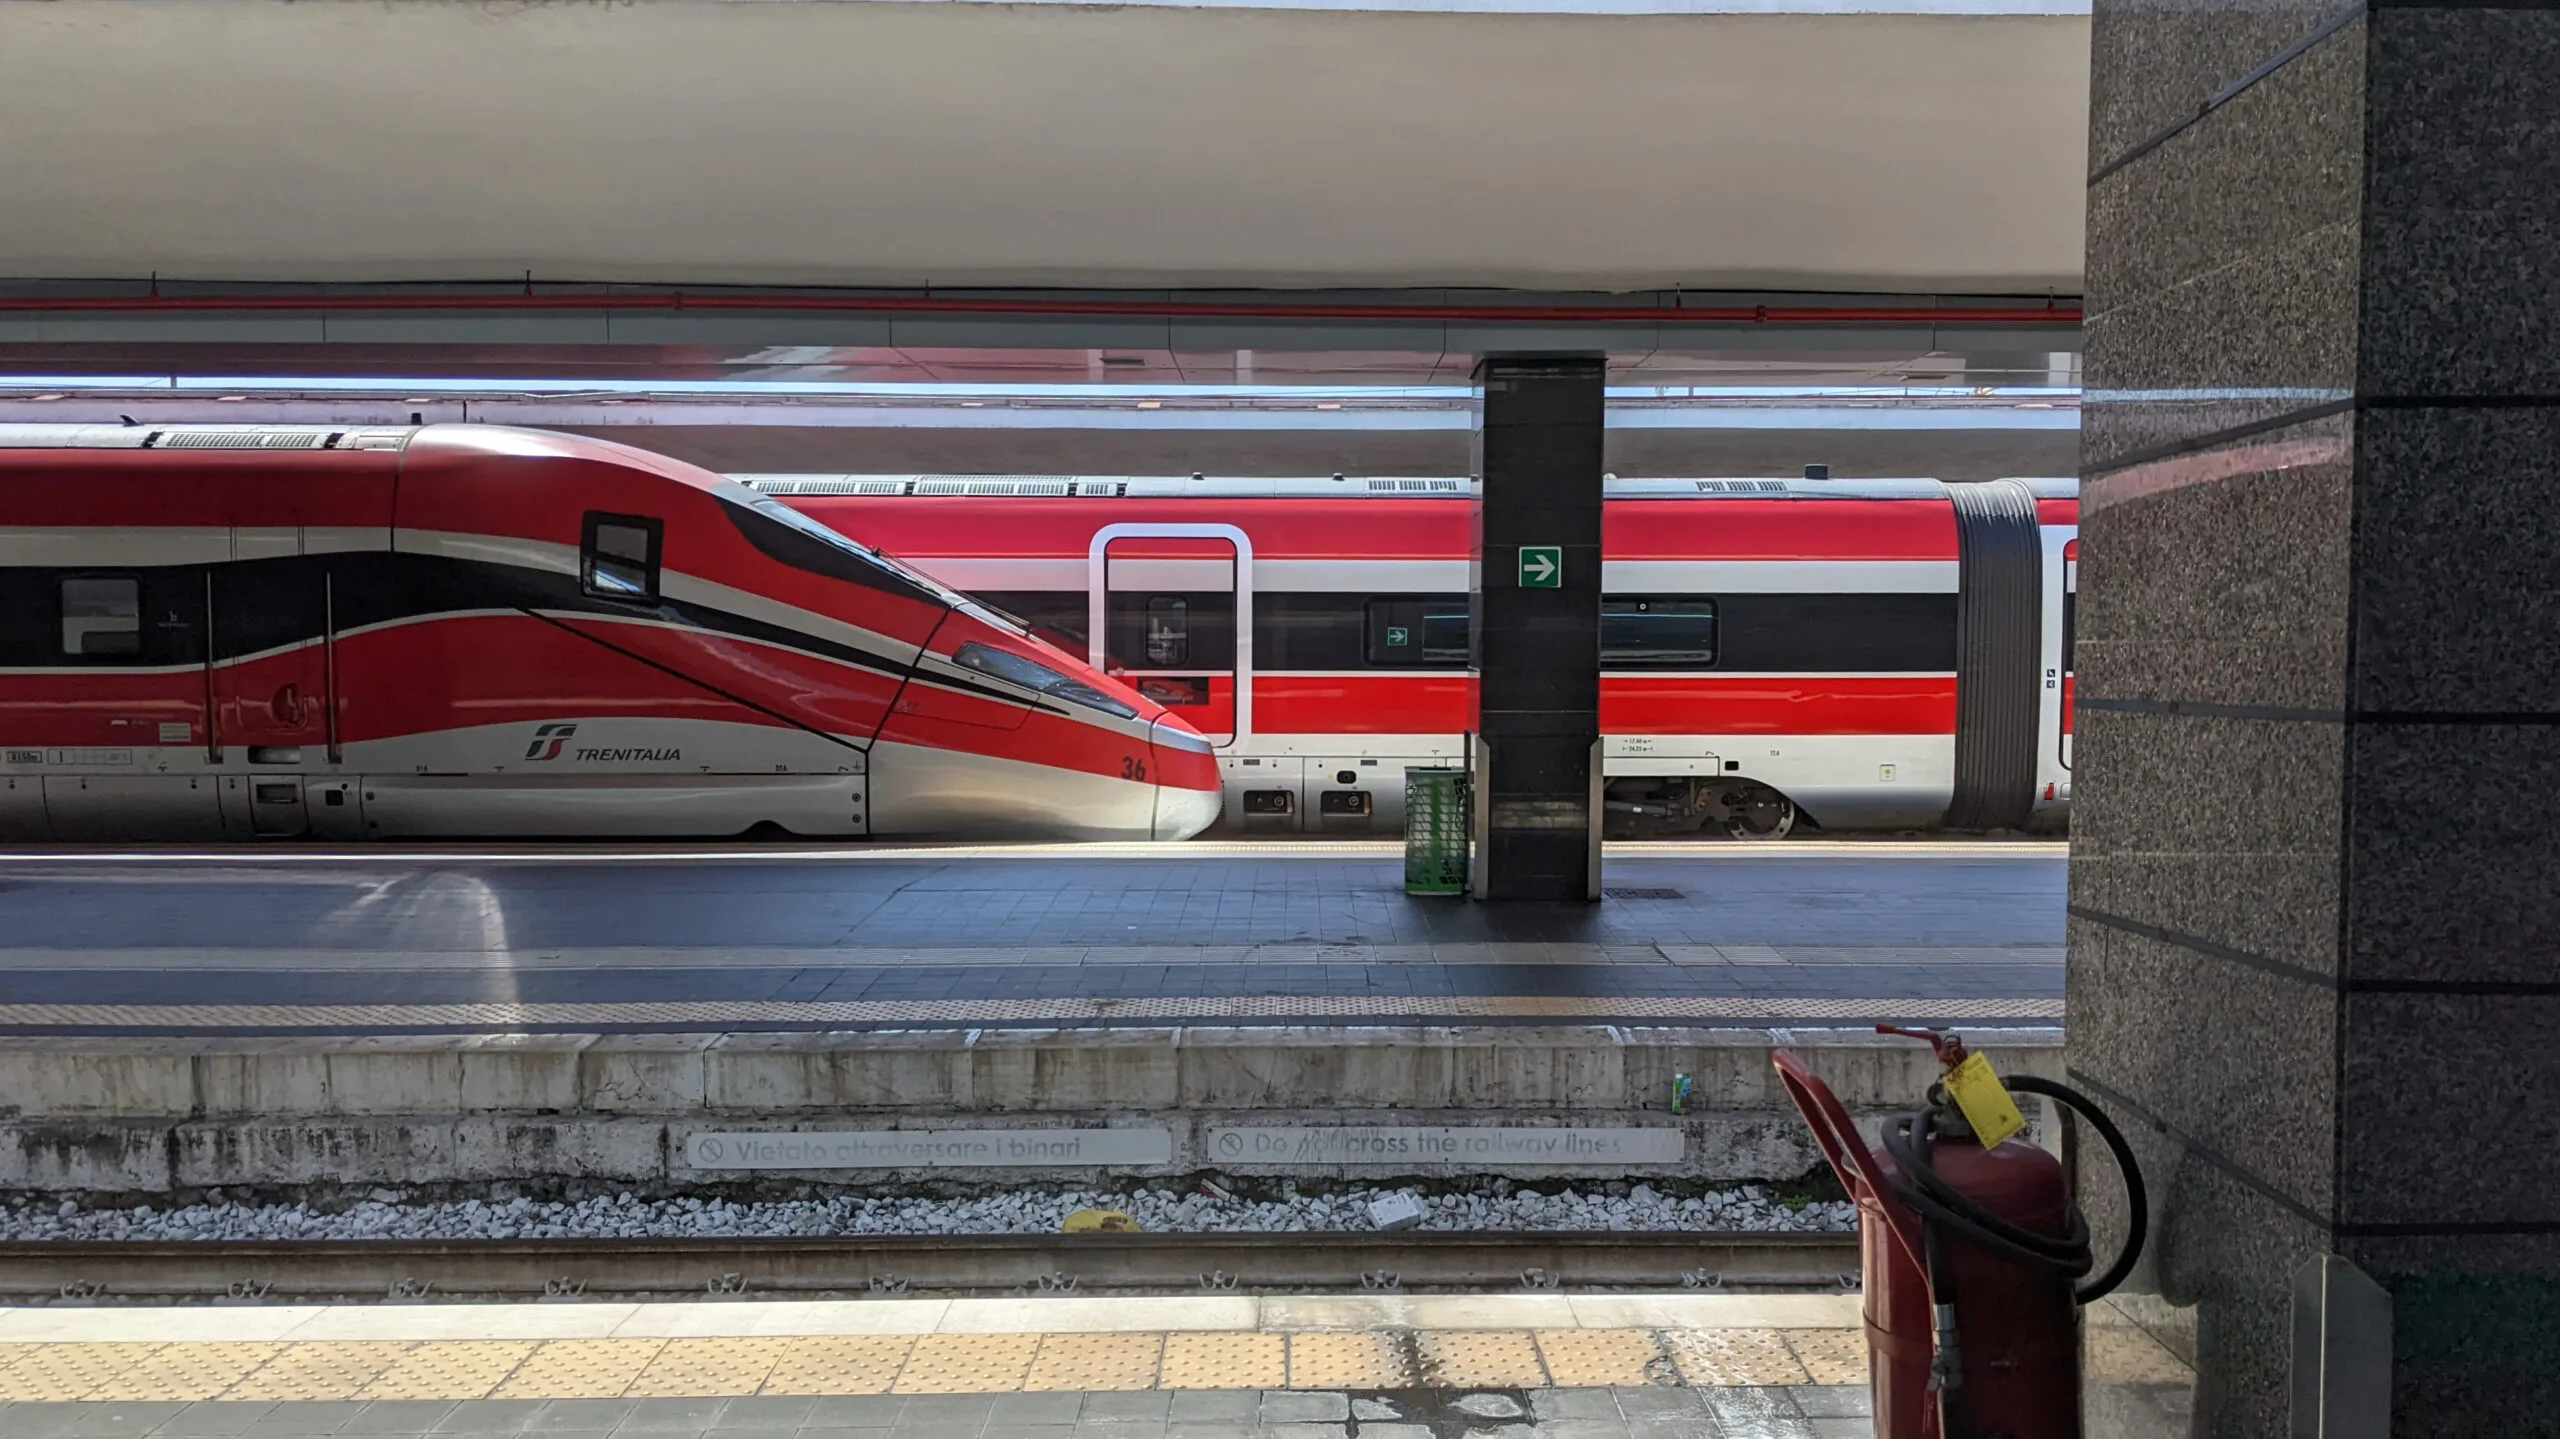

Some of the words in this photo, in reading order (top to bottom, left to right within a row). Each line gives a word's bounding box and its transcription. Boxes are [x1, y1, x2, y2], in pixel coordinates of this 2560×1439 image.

[576, 748, 681, 761] TRENITALIA
[1121, 755, 1146, 782] 36
[735, 1139, 827, 1162] Vietato
[835, 1138, 988, 1160] attraversare
[1009, 1136, 1081, 1158] binari
[1255, 1133, 1288, 1153] Do
[1345, 1136, 1409, 1153] cross
[1565, 1131, 1622, 1154] lines
